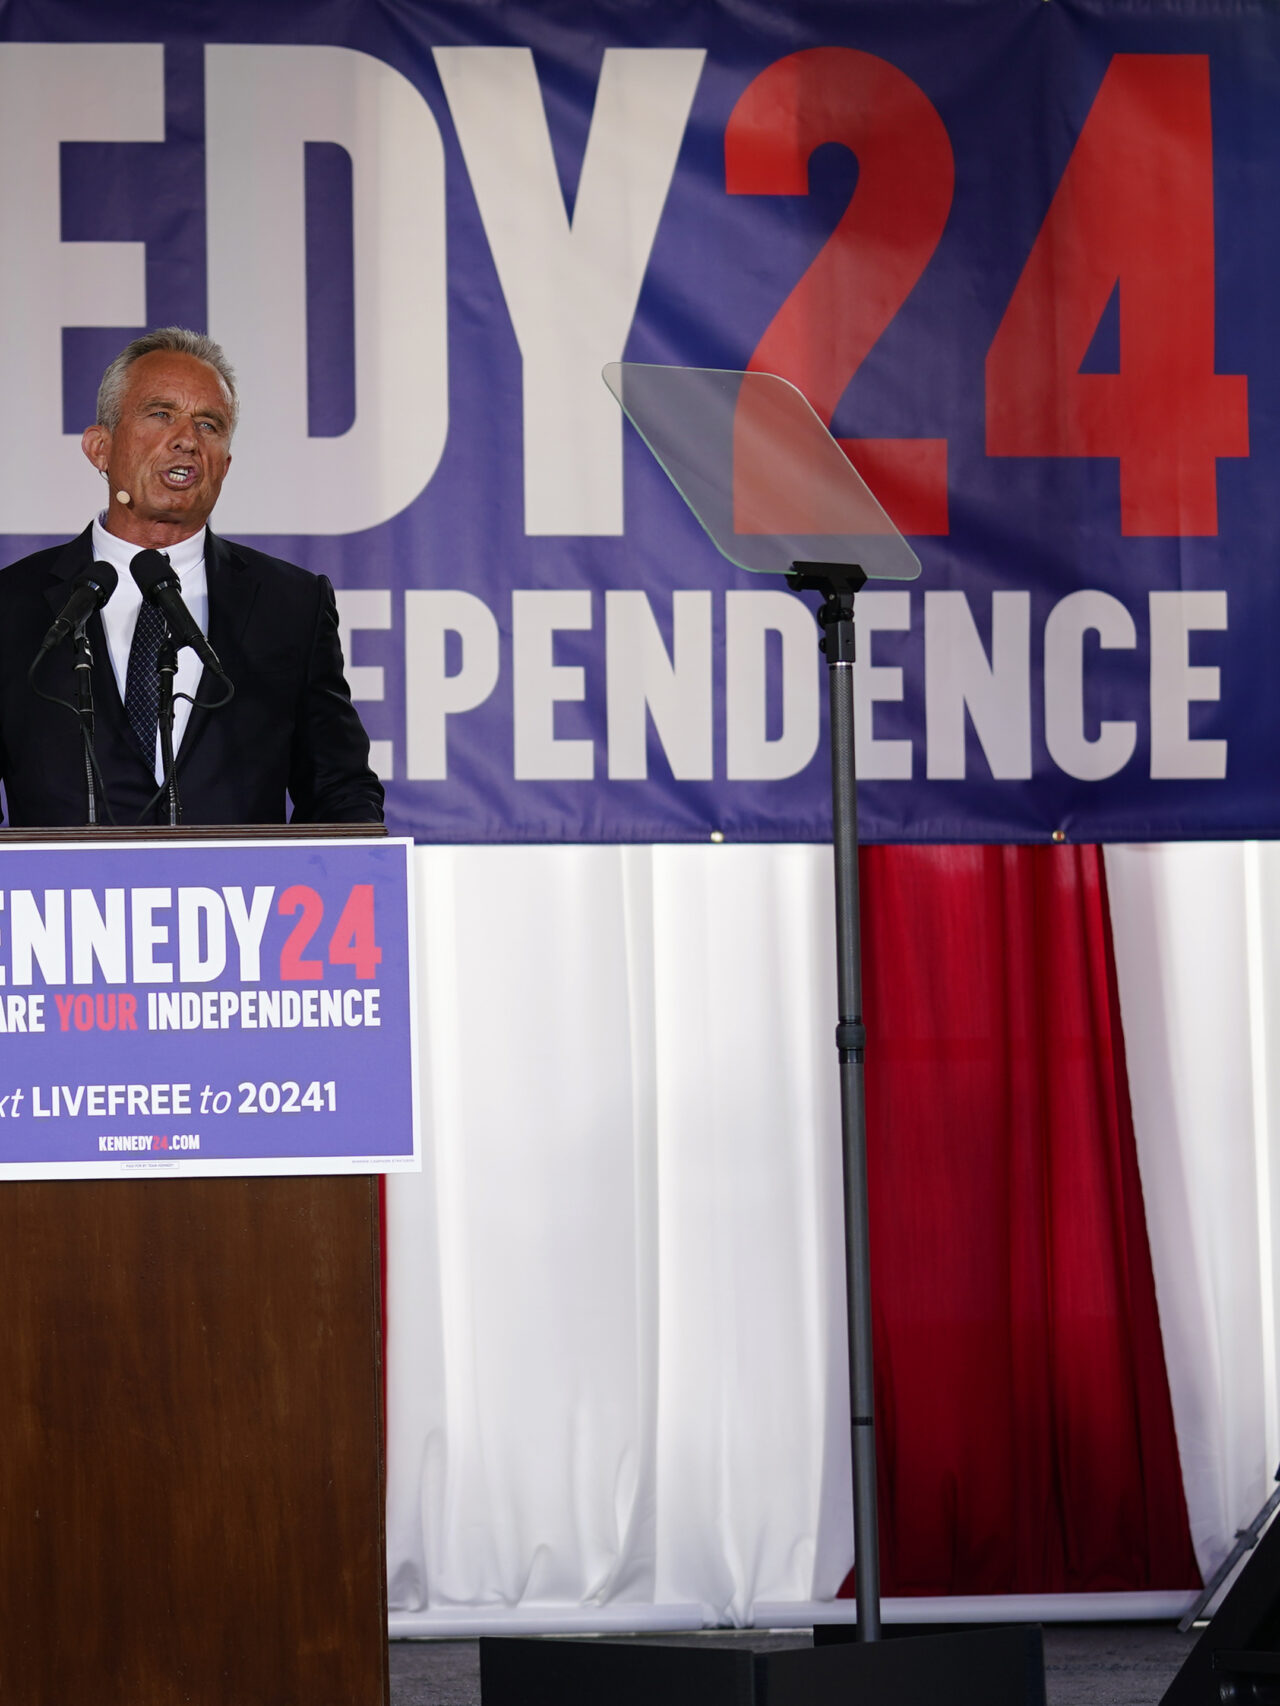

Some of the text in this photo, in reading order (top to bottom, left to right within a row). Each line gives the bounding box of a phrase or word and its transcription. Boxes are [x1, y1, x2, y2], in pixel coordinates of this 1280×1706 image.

[55, 994, 138, 1032] YOUR
[148, 989, 381, 1030] INDEPENDENCE
[32, 1084, 191, 1117] LIVEFREE
[199, 1086, 231, 1114] to
[238, 1081, 337, 1115] 20241
[98, 1134, 200, 1153] KENNEDY24.COM
